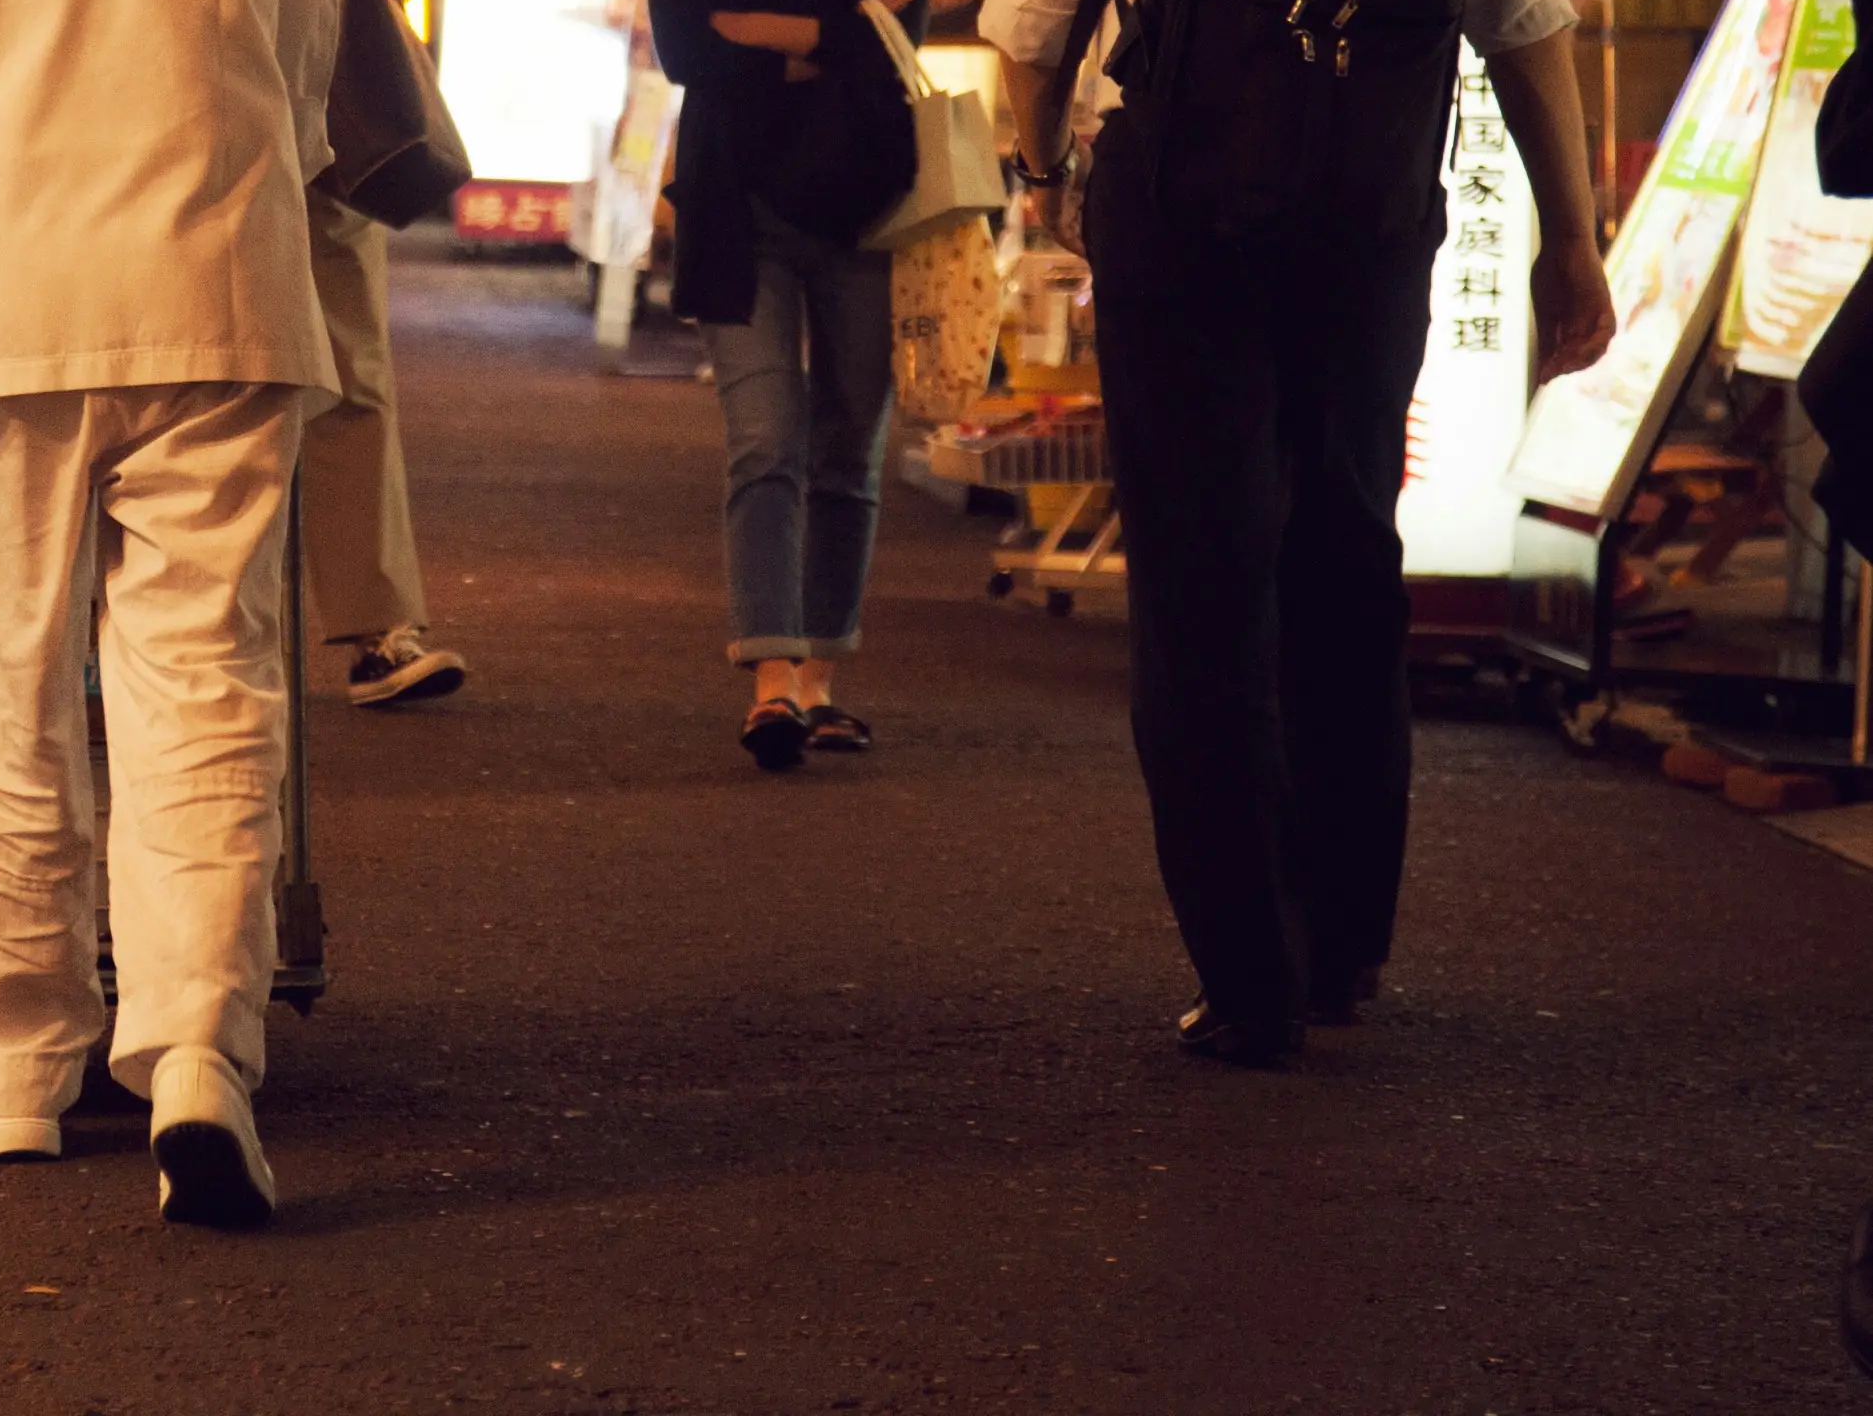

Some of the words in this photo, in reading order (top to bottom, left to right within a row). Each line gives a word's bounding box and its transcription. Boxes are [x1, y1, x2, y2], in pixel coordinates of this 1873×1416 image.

[1452, 62, 1507, 354] 中国家庭料理
